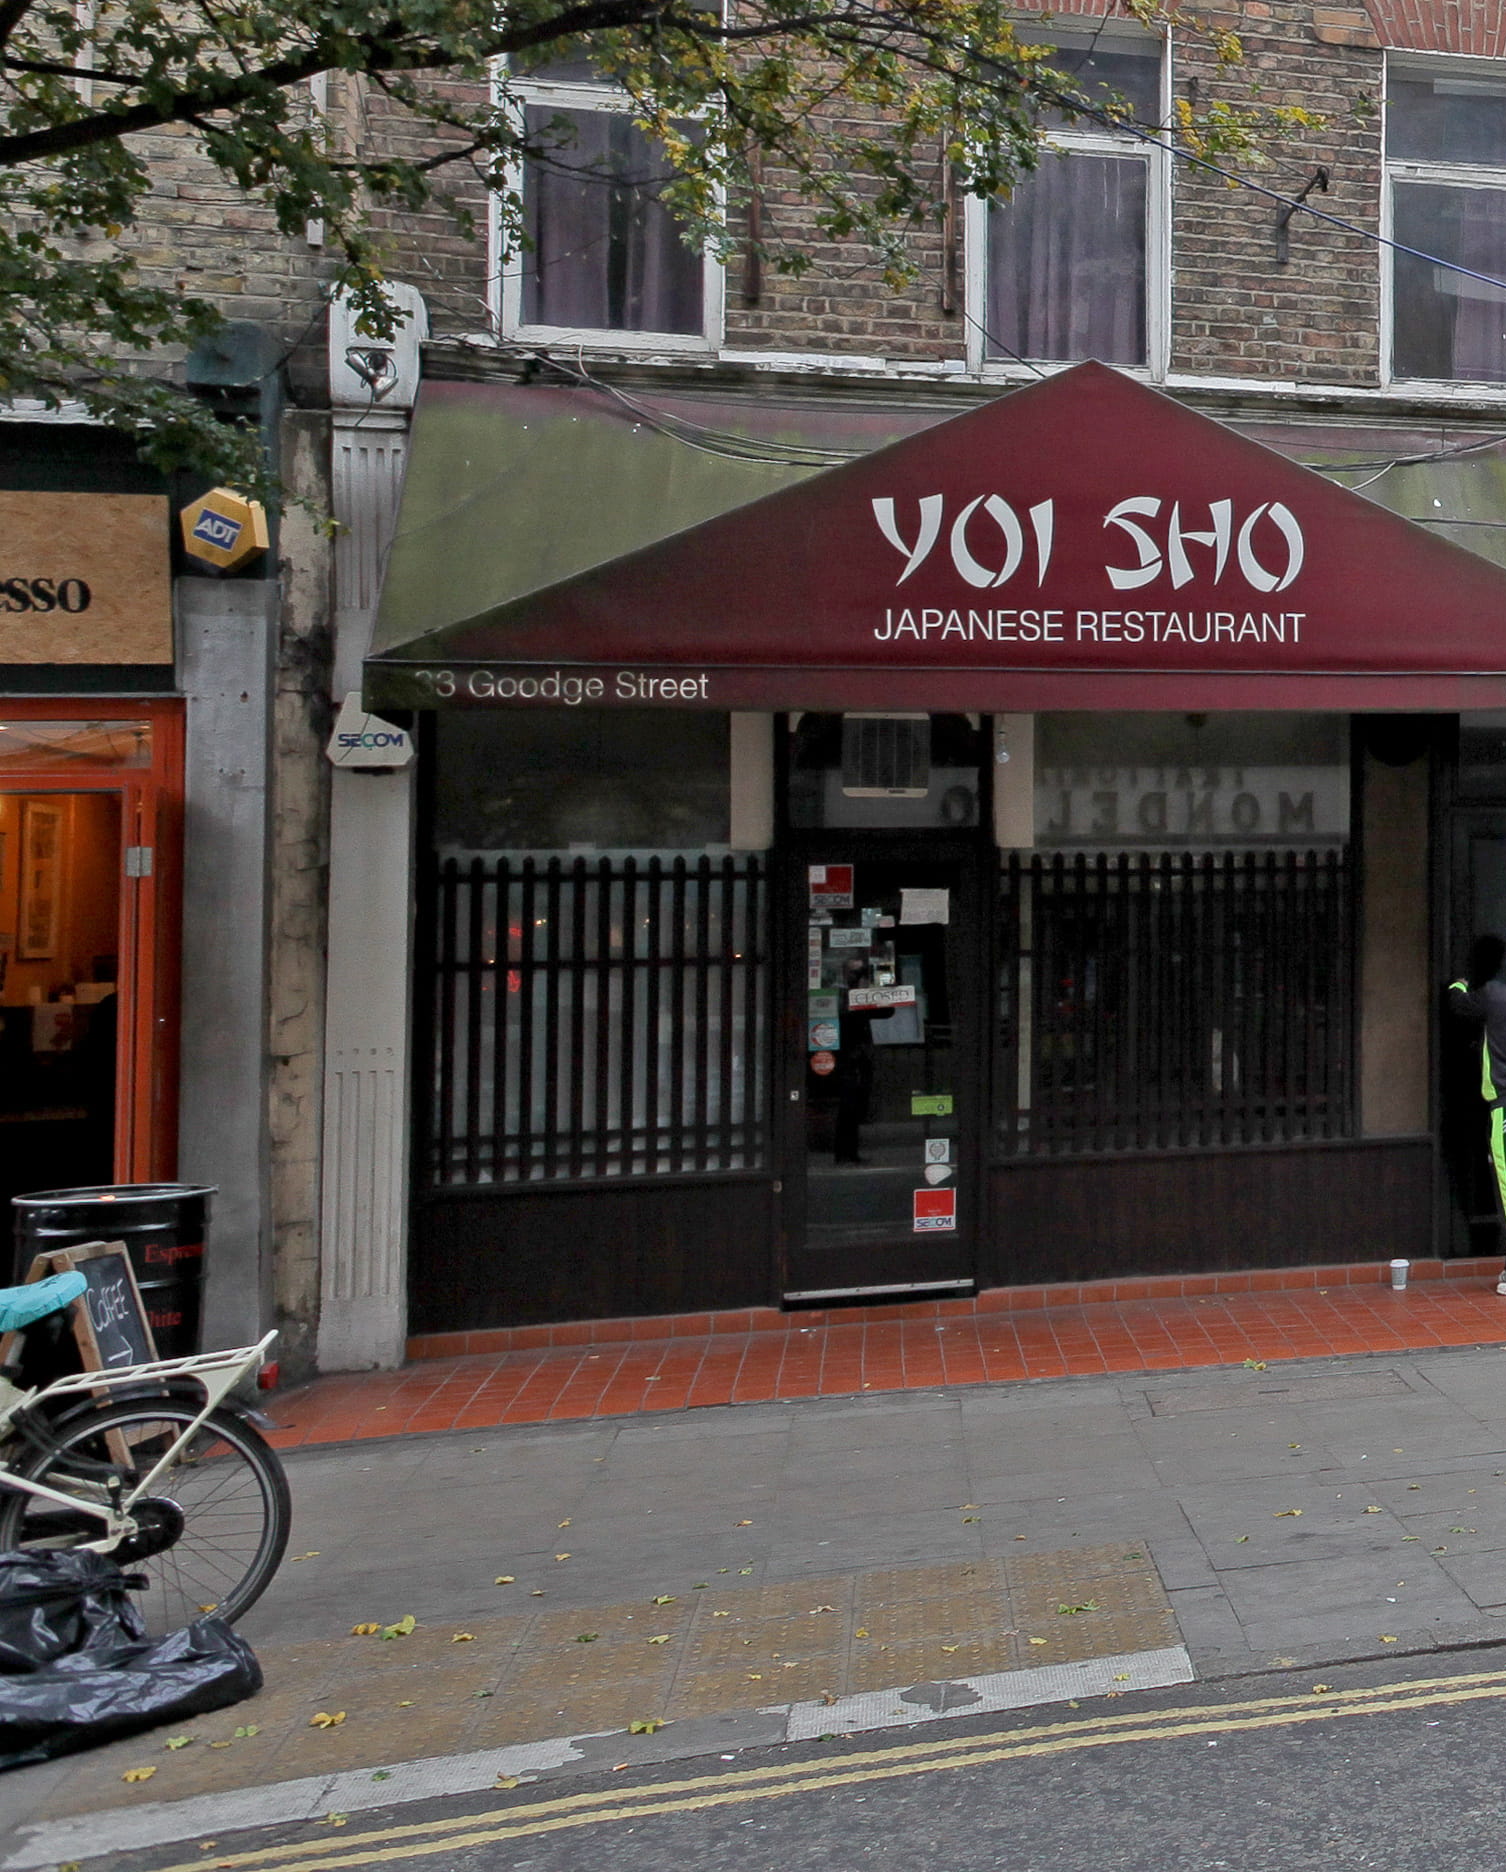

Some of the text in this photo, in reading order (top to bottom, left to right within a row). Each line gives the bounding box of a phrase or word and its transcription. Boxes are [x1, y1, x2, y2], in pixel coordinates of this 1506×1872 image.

[196, 518, 238, 543] ADT
[870, 493, 1305, 593] YOI SHO
[0, 577, 92, 614] sso
[873, 609, 1307, 643] JAPANESE RESTAURANT
[468, 670, 604, 705] Goodge
[615, 671, 709, 699] Street
[338, 733, 405, 748] SECOM
[855, 989, 910, 1006] CLOSED
